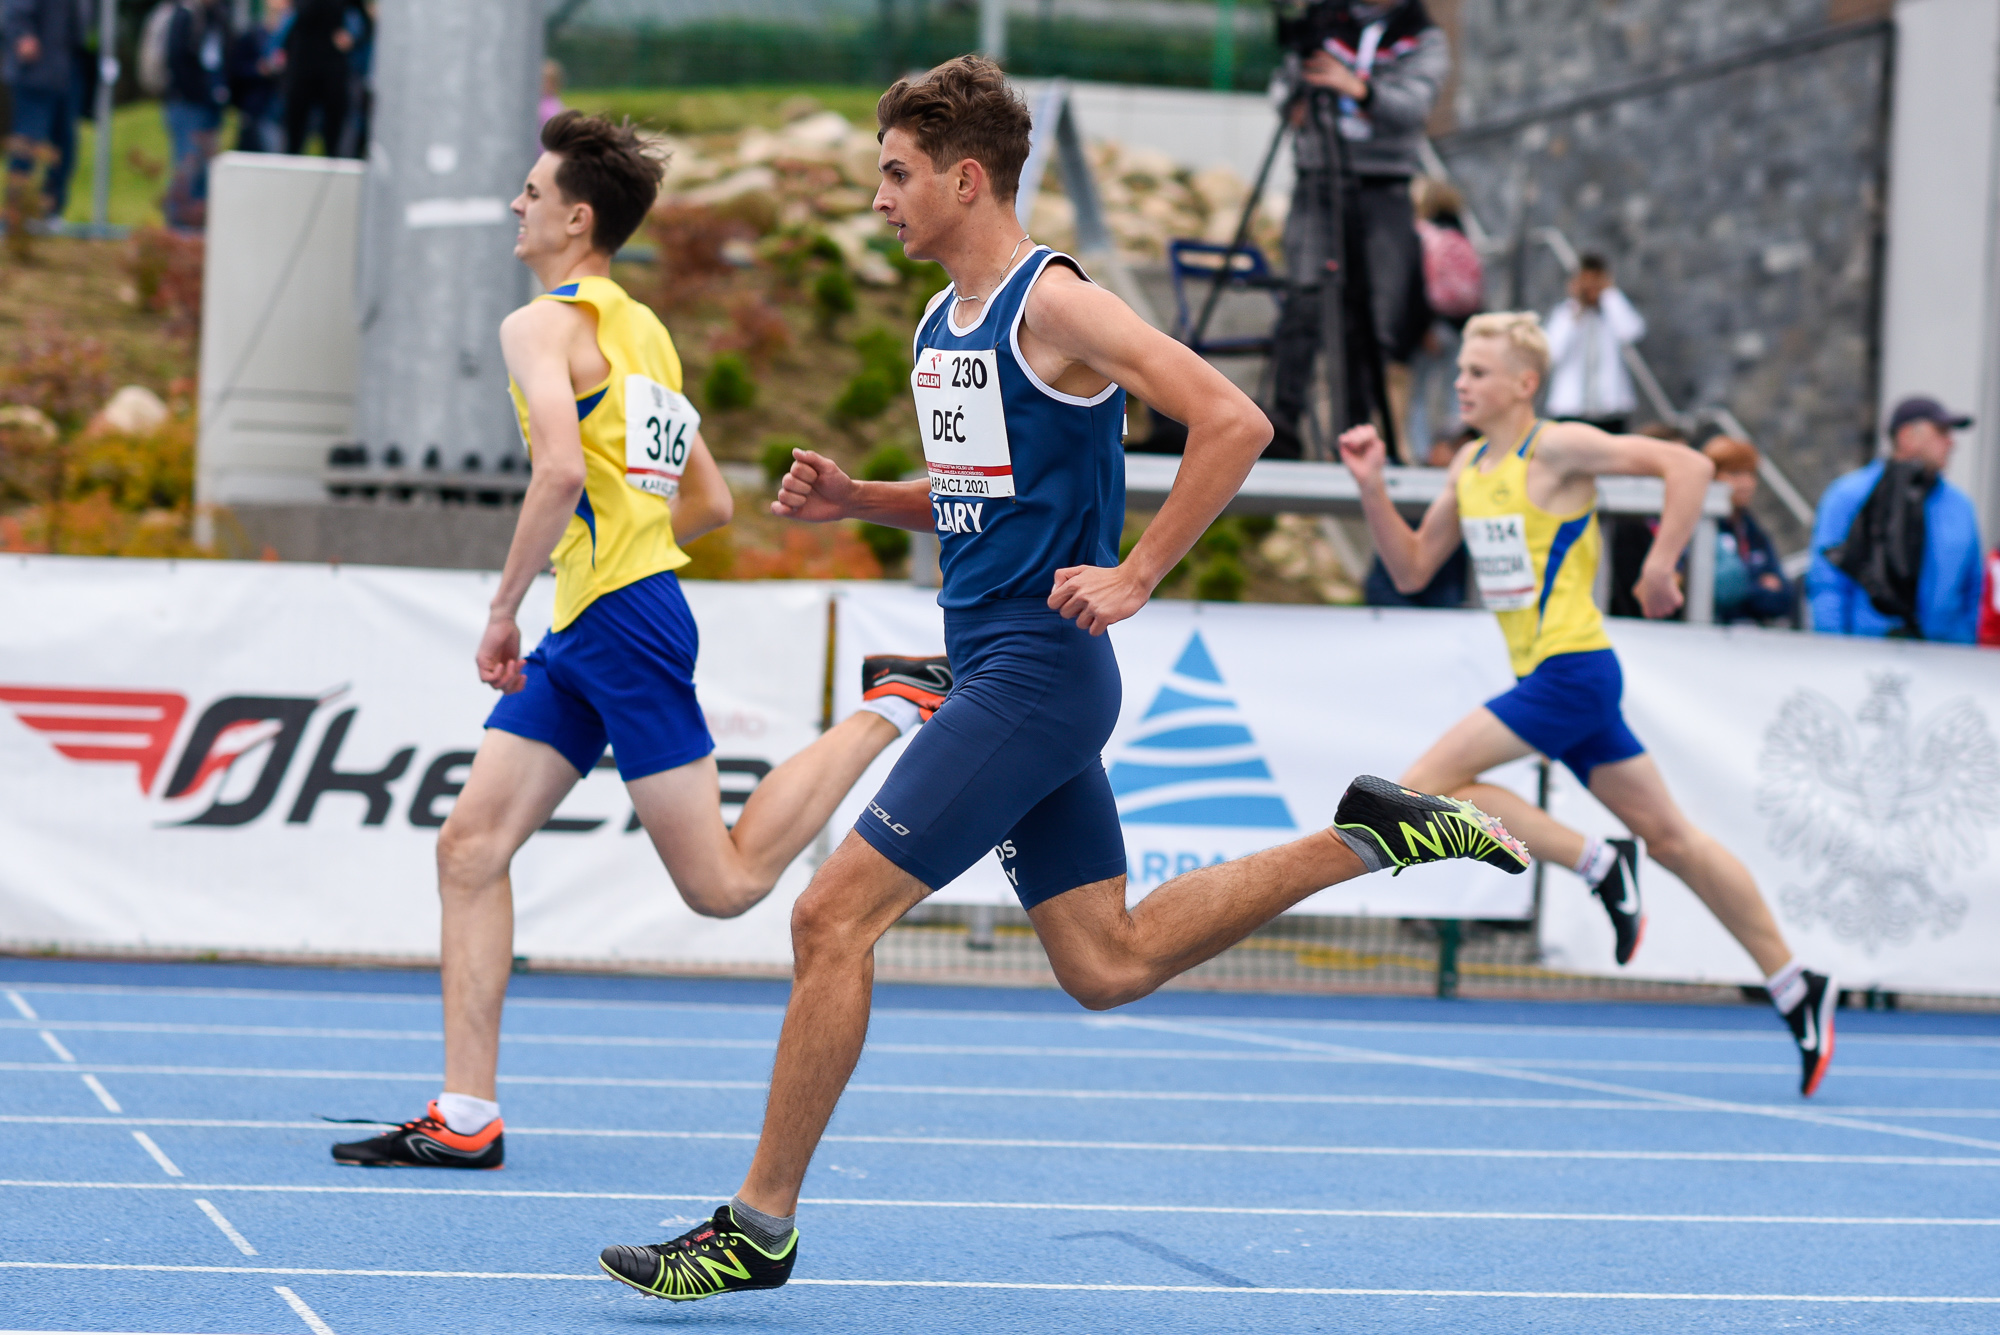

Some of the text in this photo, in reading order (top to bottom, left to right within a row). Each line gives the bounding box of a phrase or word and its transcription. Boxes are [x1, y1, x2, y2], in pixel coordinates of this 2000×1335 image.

[917, 375, 940, 388] ORLEN
[952, 356, 988, 389] 230
[646, 416, 687, 467] 316
[932, 405, 967, 443] DEĆ
[931, 476, 990, 495] ARPACZ 2021
[867, 800, 911, 837] COLO
